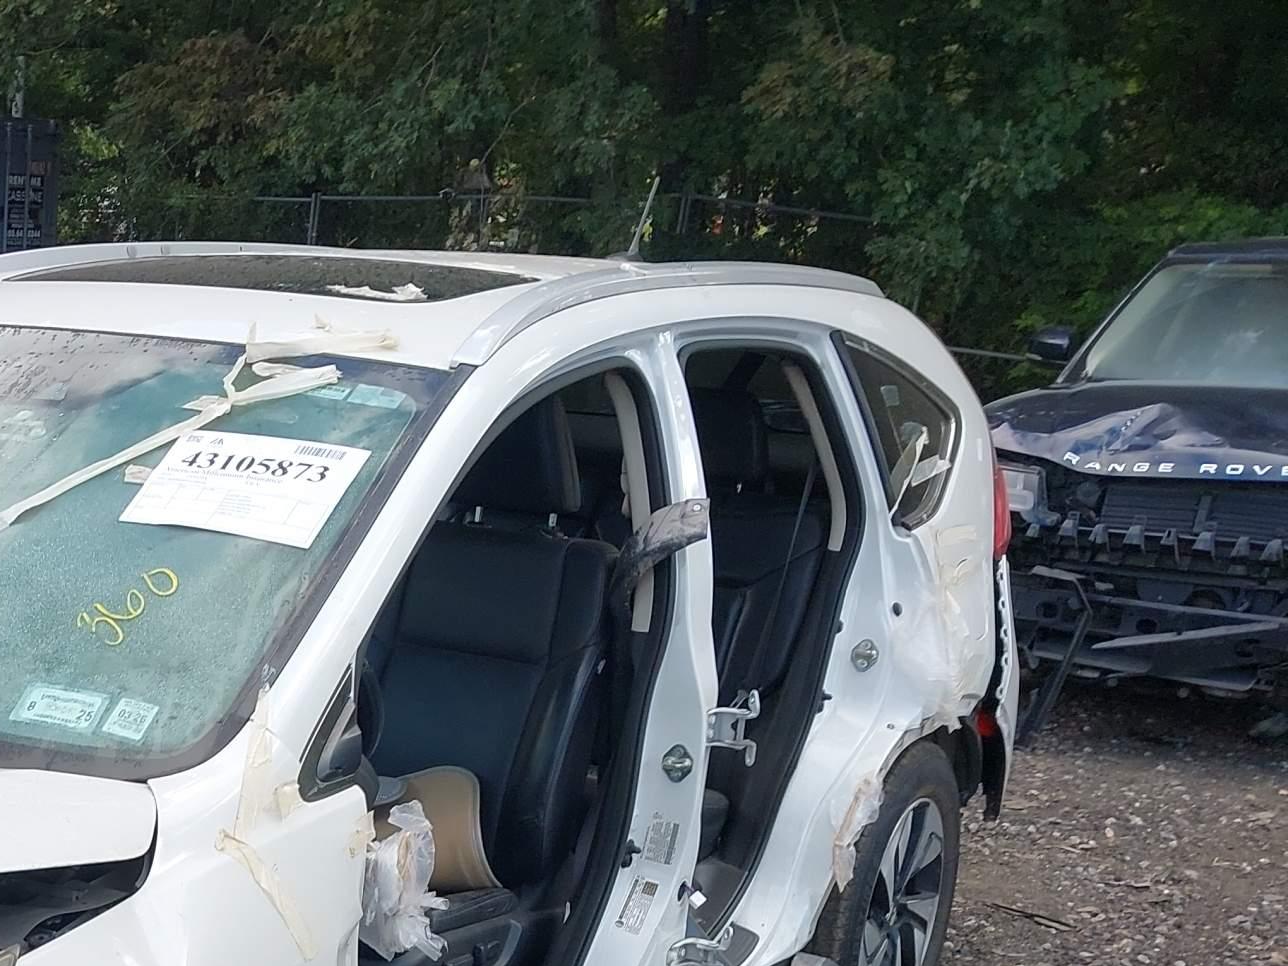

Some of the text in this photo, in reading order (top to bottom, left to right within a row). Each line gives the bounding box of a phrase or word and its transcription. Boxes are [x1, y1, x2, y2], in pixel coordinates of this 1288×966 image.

[181, 450, 330, 483] 43105873
[1063, 451, 1176, 473] RANGE
[75, 709, 96, 722] 25
